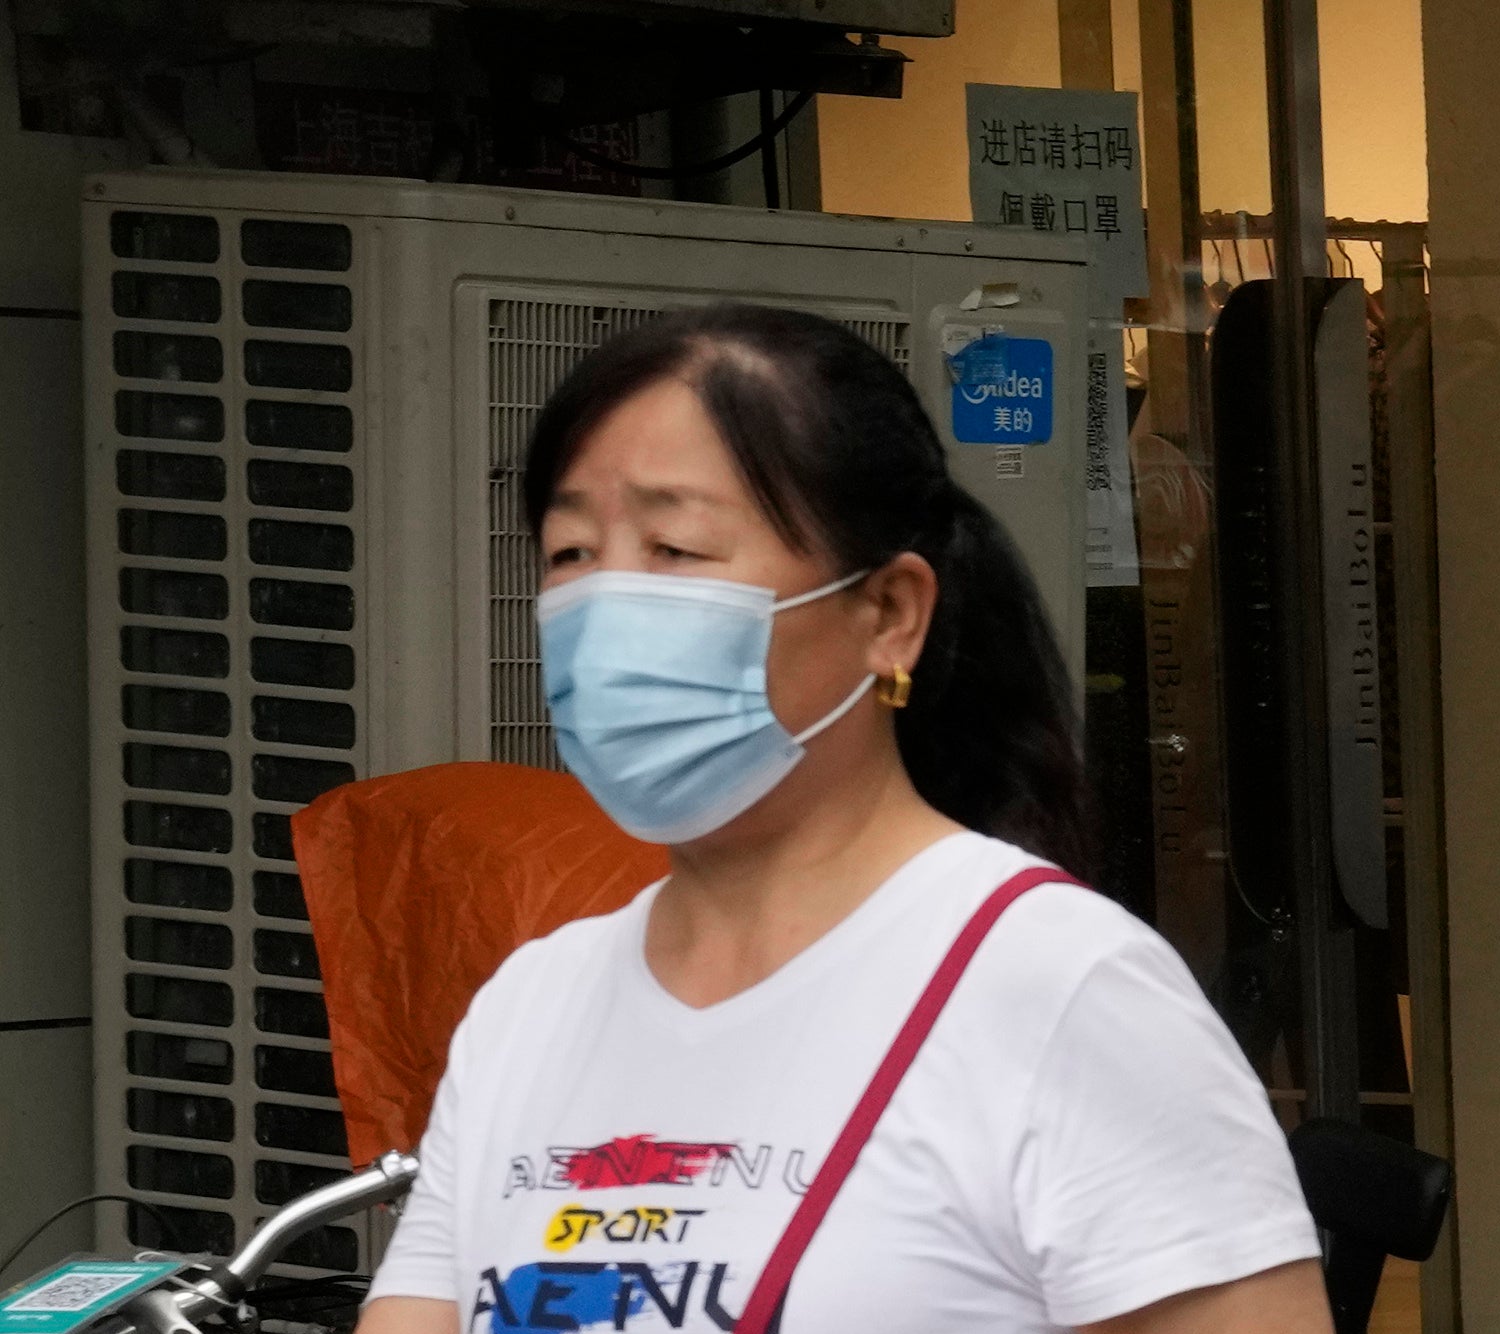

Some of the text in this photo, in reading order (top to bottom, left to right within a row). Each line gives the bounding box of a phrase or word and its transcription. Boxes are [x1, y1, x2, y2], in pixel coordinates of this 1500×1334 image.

[979, 120, 1133, 170] 进店请扫码
[1002, 192, 1121, 241] 佩戴口罩
[993, 406, 1033, 433] 美的
[551, 1208, 706, 1244] SPORT
